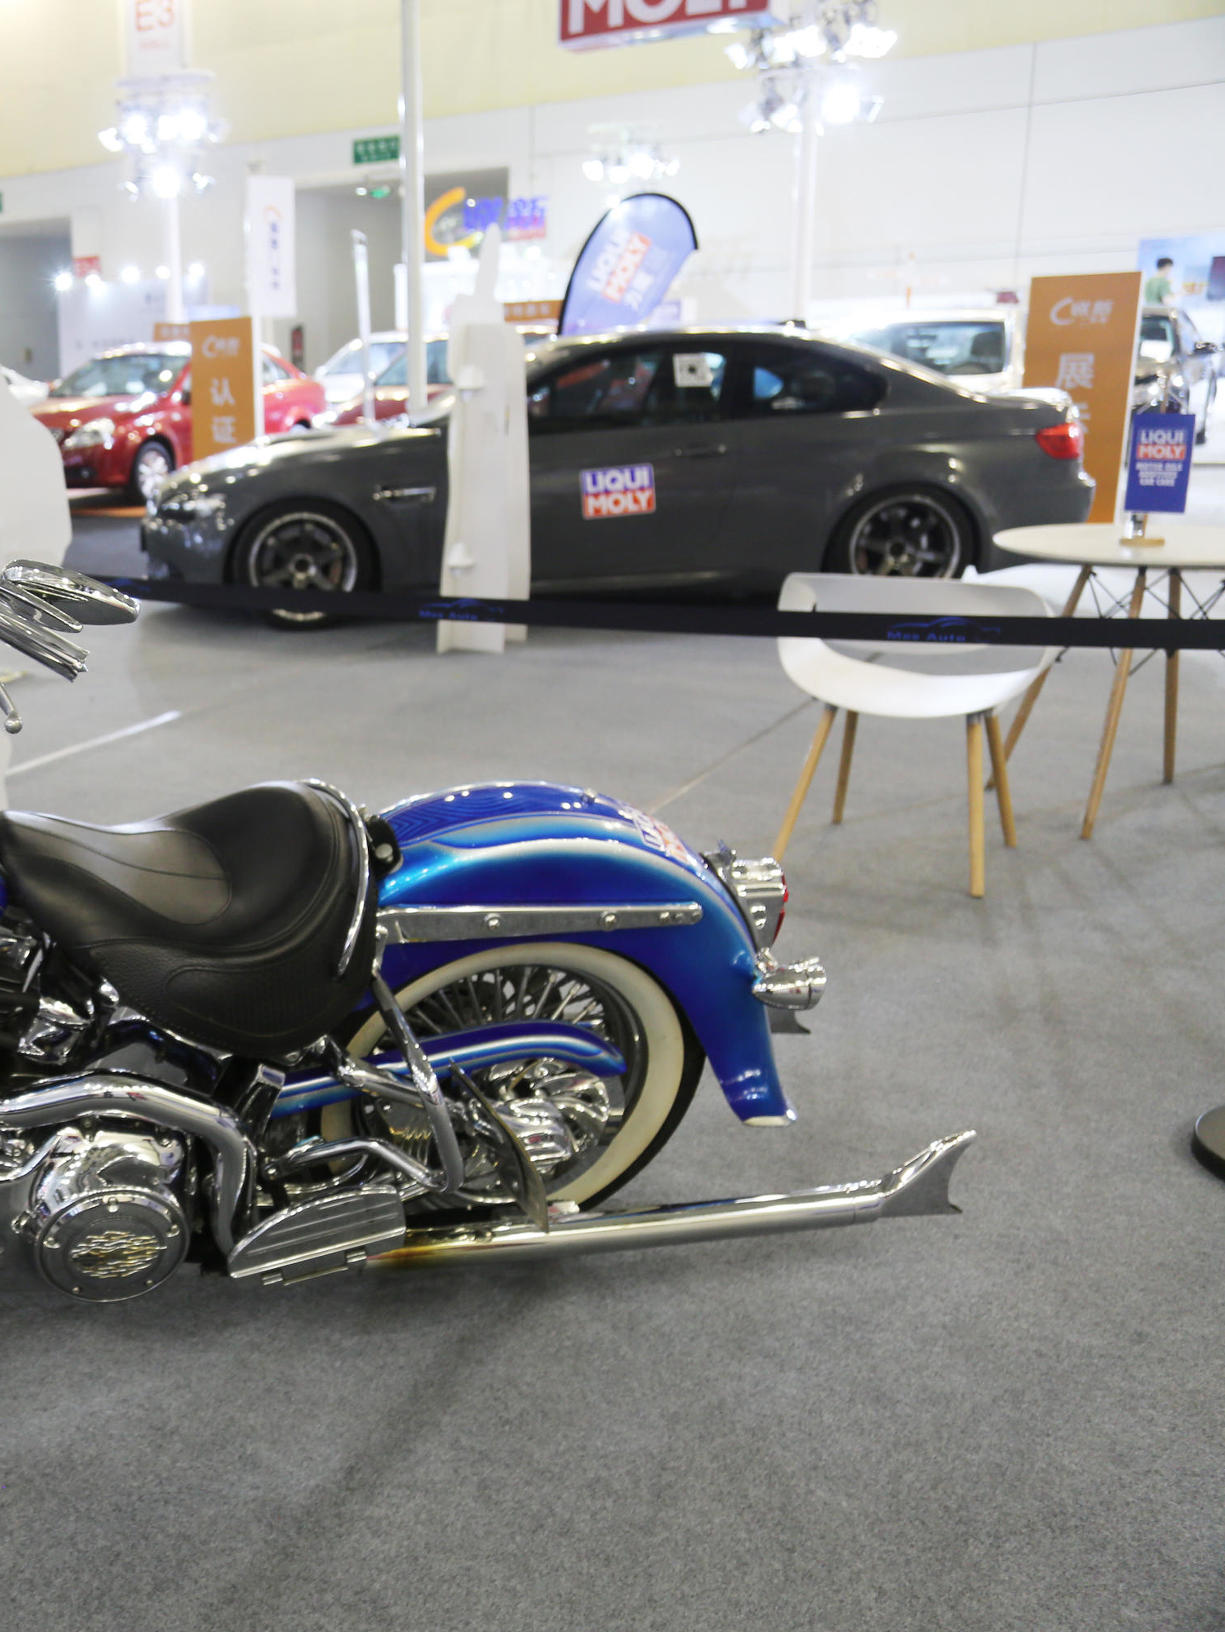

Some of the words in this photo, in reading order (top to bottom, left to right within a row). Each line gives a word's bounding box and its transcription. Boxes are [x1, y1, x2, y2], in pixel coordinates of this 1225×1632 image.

[1140, 430, 1184, 445] LIQUI
[1138, 445, 1185, 460] MOLY
[585, 466, 649, 494] LIQUI
[587, 491, 651, 515] MOLY
